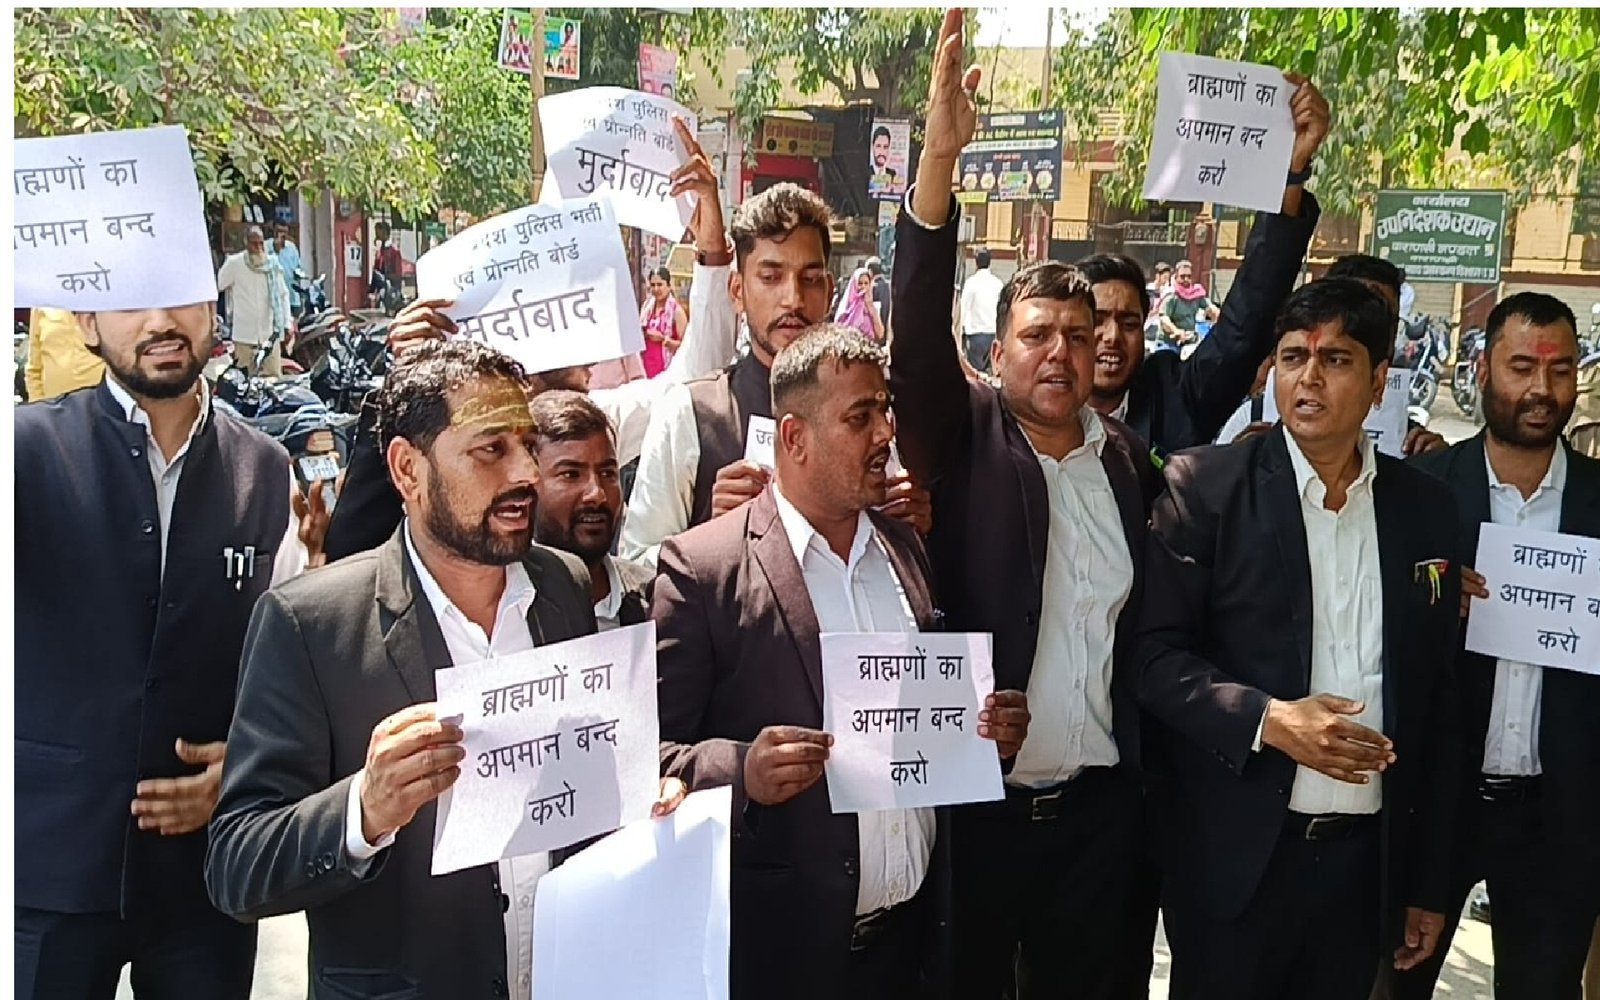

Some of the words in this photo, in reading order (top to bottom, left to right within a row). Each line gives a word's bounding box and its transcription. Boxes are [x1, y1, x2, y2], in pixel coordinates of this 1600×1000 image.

[1255, 83, 1278, 107] का
[1176, 117, 1236, 146] अपमान
[14, 155, 86, 196] ाह्मणों
[100, 158, 138, 187] का
[575, 146, 674, 202] मुर्दाबाद
[1198, 158, 1227, 187] करो
[14, 218, 89, 250] पमान
[514, 213, 564, 244] पुलिस
[570, 202, 602, 224] भर्ती
[56, 260, 111, 293] करो
[483, 249, 540, 282] प्रोन्नति
[1500, 583, 1576, 614] अपमान
[1537, 626, 1581, 654] करो
[858, 645, 927, 682] ब्राह्मणों
[936, 655, 964, 681] का
[482, 664, 569, 718] ब्राह्मणों
[581, 663, 614, 694] का
[852, 707, 921, 734] अपमान
[930, 706, 967, 732] बन्द
[476, 732, 561, 779] अपमान
[574, 718, 620, 751] बन्द
[889, 750, 929, 787] करो
[528, 780, 577, 826] करो
